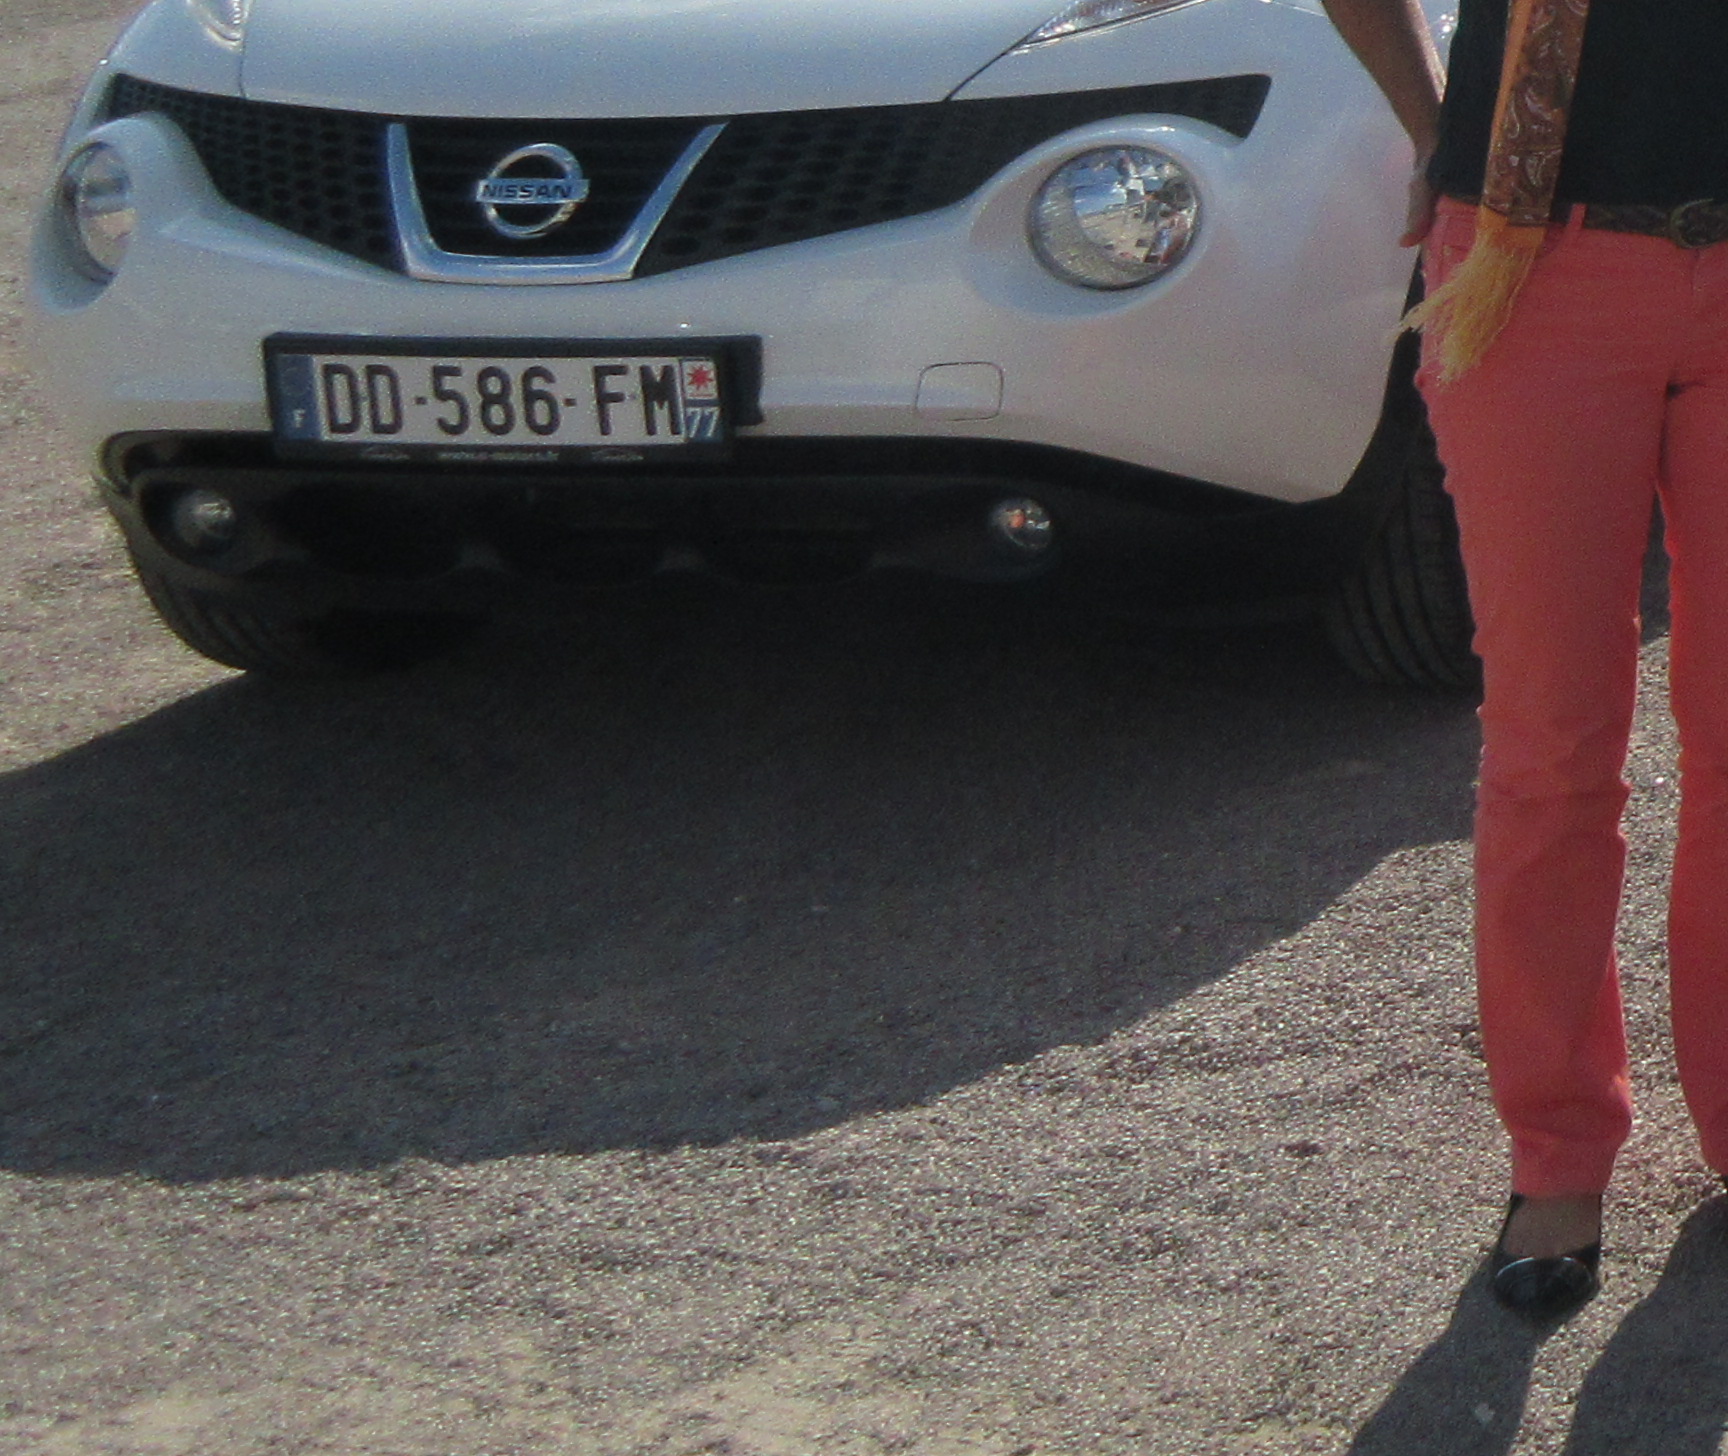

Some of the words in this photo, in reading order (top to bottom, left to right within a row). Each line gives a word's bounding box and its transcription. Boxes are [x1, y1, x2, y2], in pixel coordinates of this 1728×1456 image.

[483, 184, 572, 199] NISSAN
[322, 362, 683, 437] DD-586-FM
[293, 409, 306, 428] F
[685, 406, 719, 438] 77
